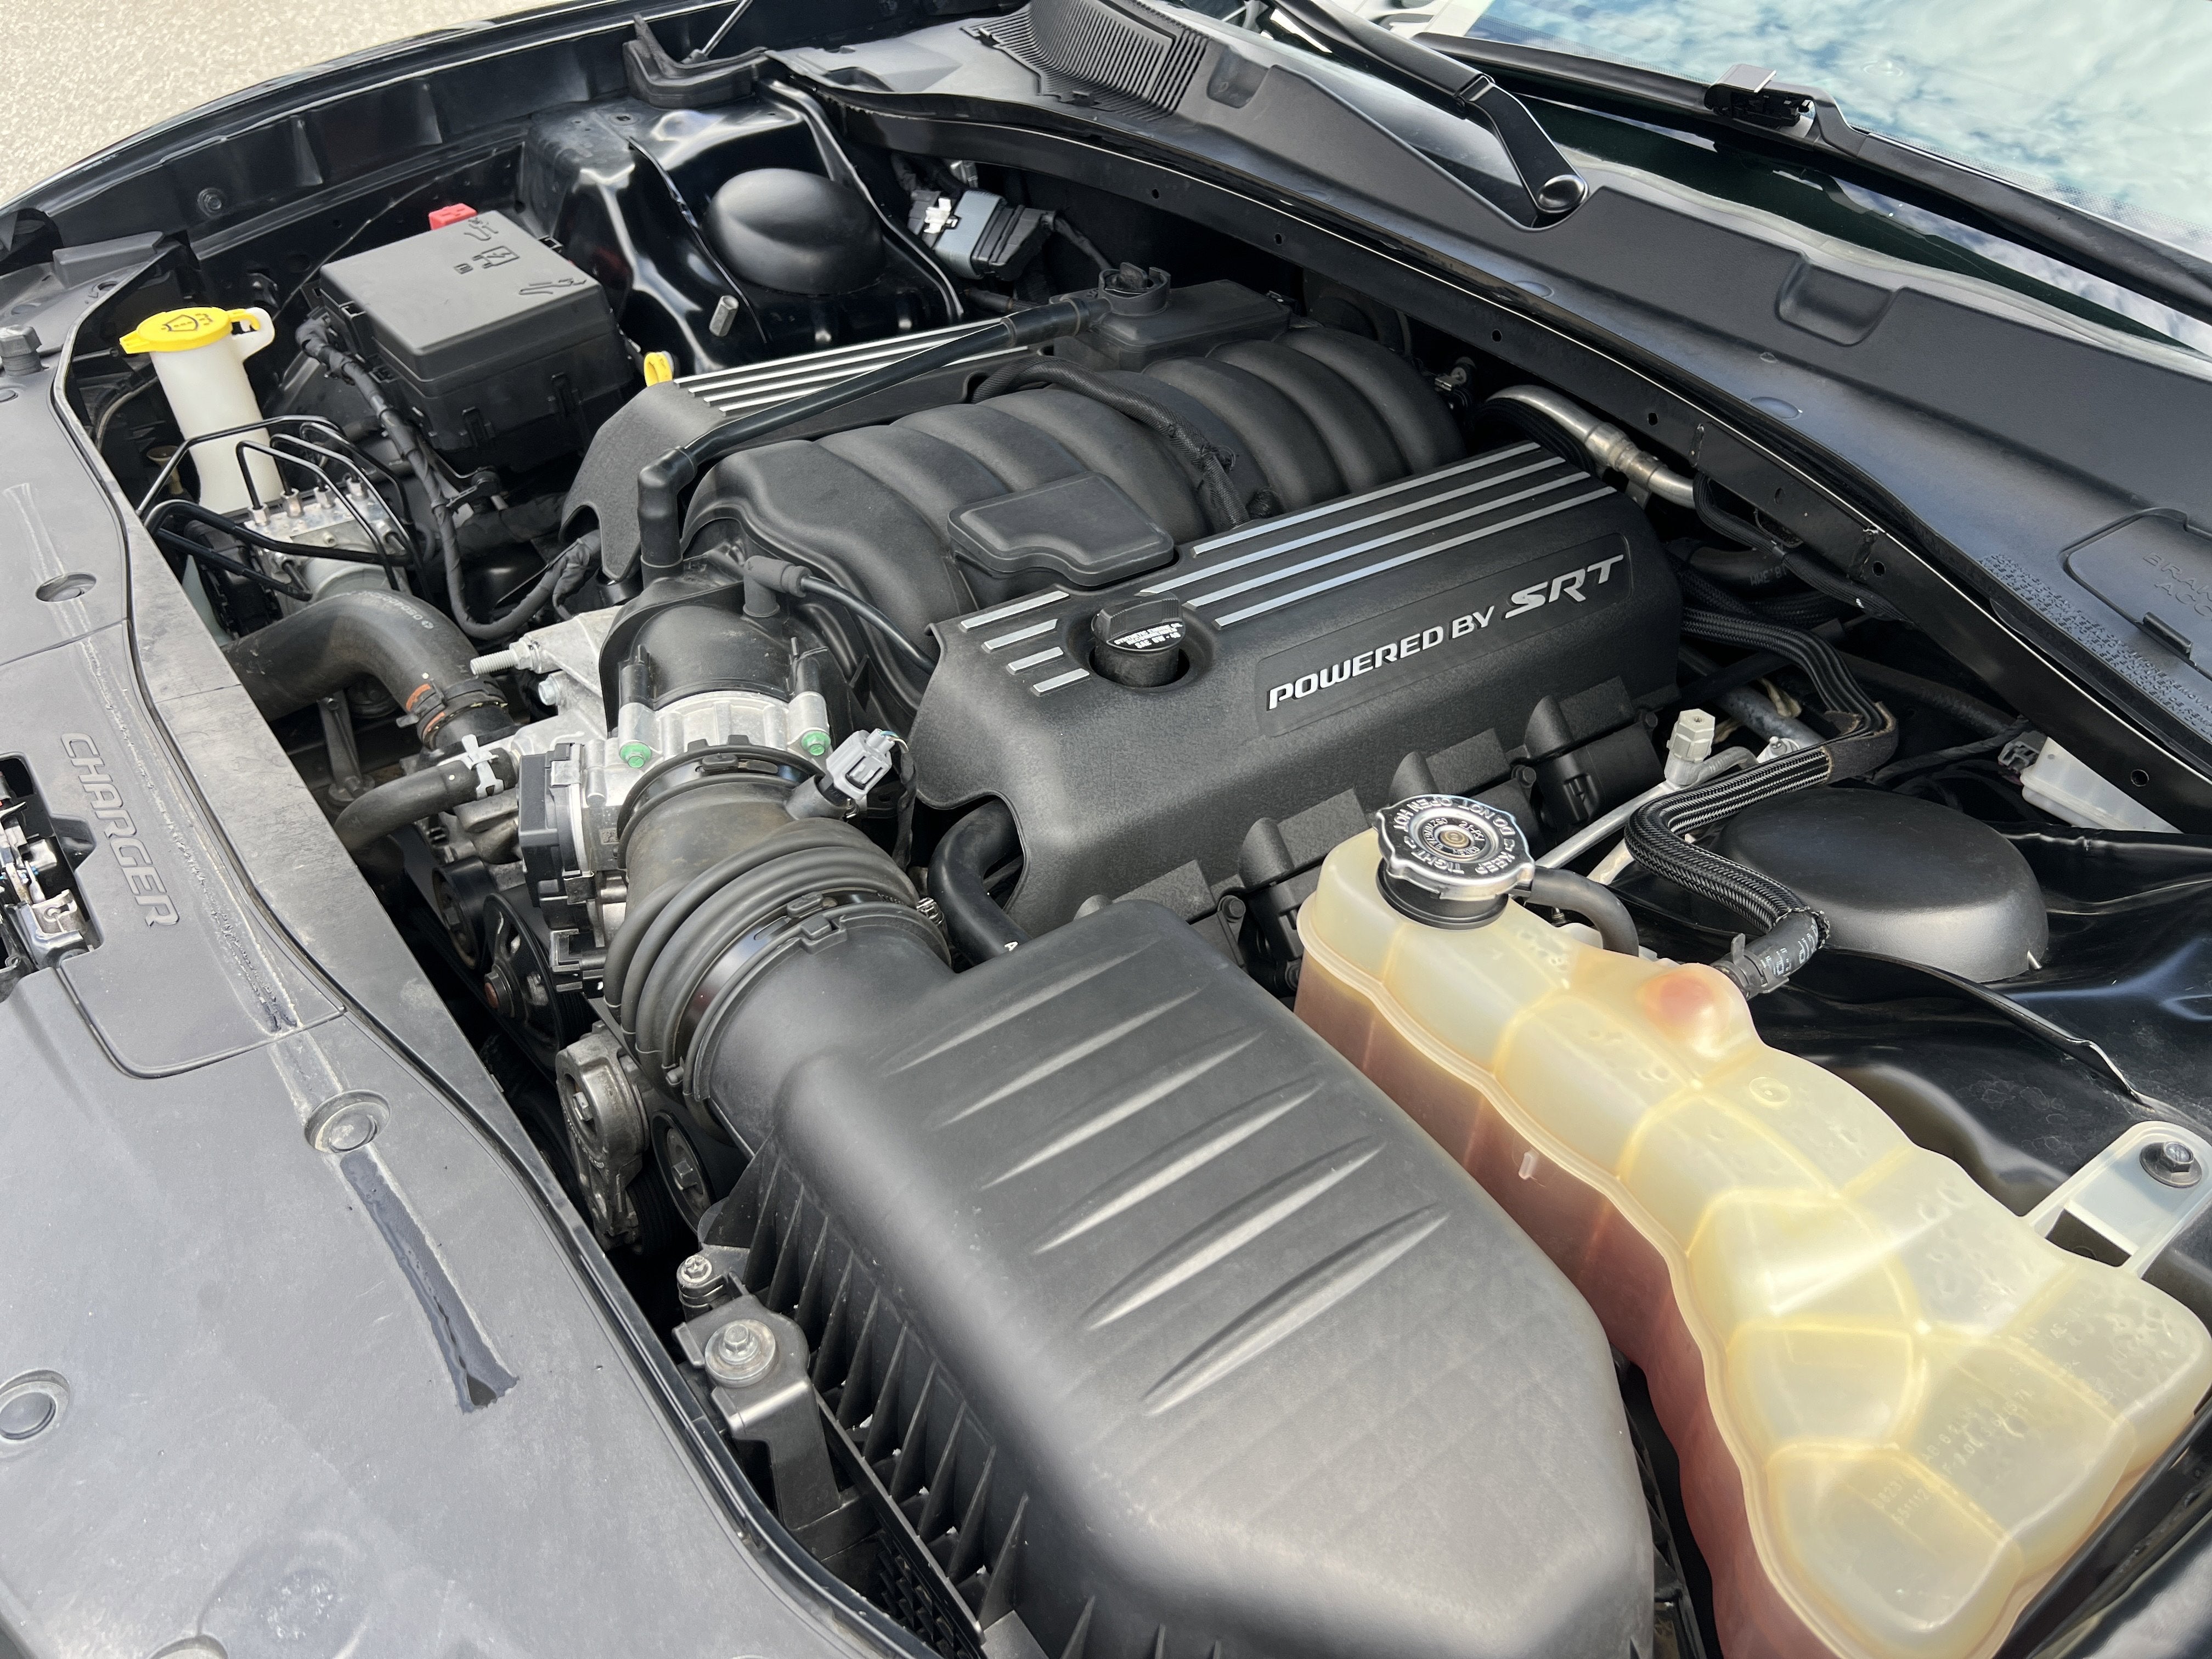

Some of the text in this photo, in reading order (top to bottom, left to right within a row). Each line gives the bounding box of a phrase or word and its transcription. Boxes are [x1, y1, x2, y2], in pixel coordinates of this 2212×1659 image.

[1135, 639, 1152, 648] SAE
[1268, 554, 1624, 710] POWERED BY SRT
[60, 732, 180, 927] CHARGER
[1393, 797, 1516, 836] DO NOT OPEN HOT
[1410, 850, 1516, 875] KEEP TIGHT
[1452, 846, 1480, 855] MEXICO
